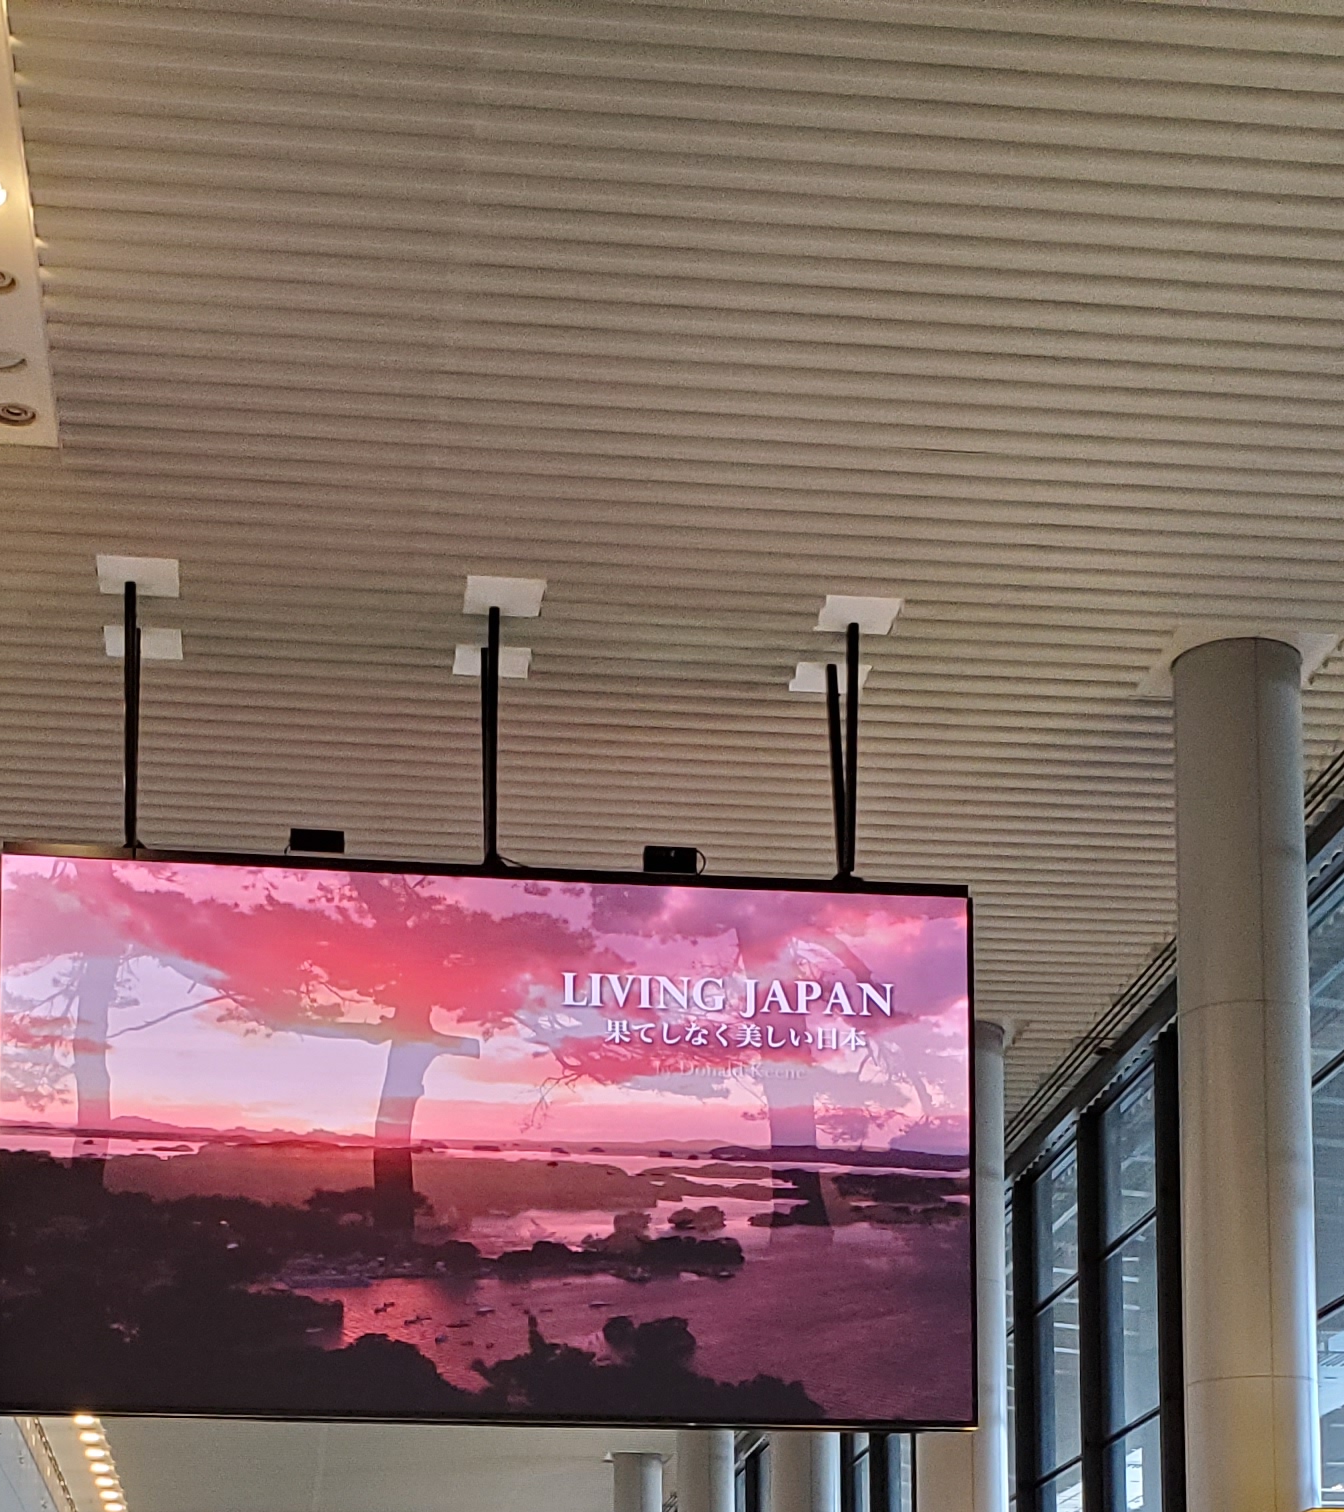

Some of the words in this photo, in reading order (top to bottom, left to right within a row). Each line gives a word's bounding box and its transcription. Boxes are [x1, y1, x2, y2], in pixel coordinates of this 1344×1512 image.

[561, 972, 725, 1011] LIVING
[739, 979, 894, 1018] JAPAN
[604, 1019, 867, 1051] 果てしなく美しい日本
[680, 1062, 744, 1077] Donald
[752, 1063, 806, 1080] Keene
